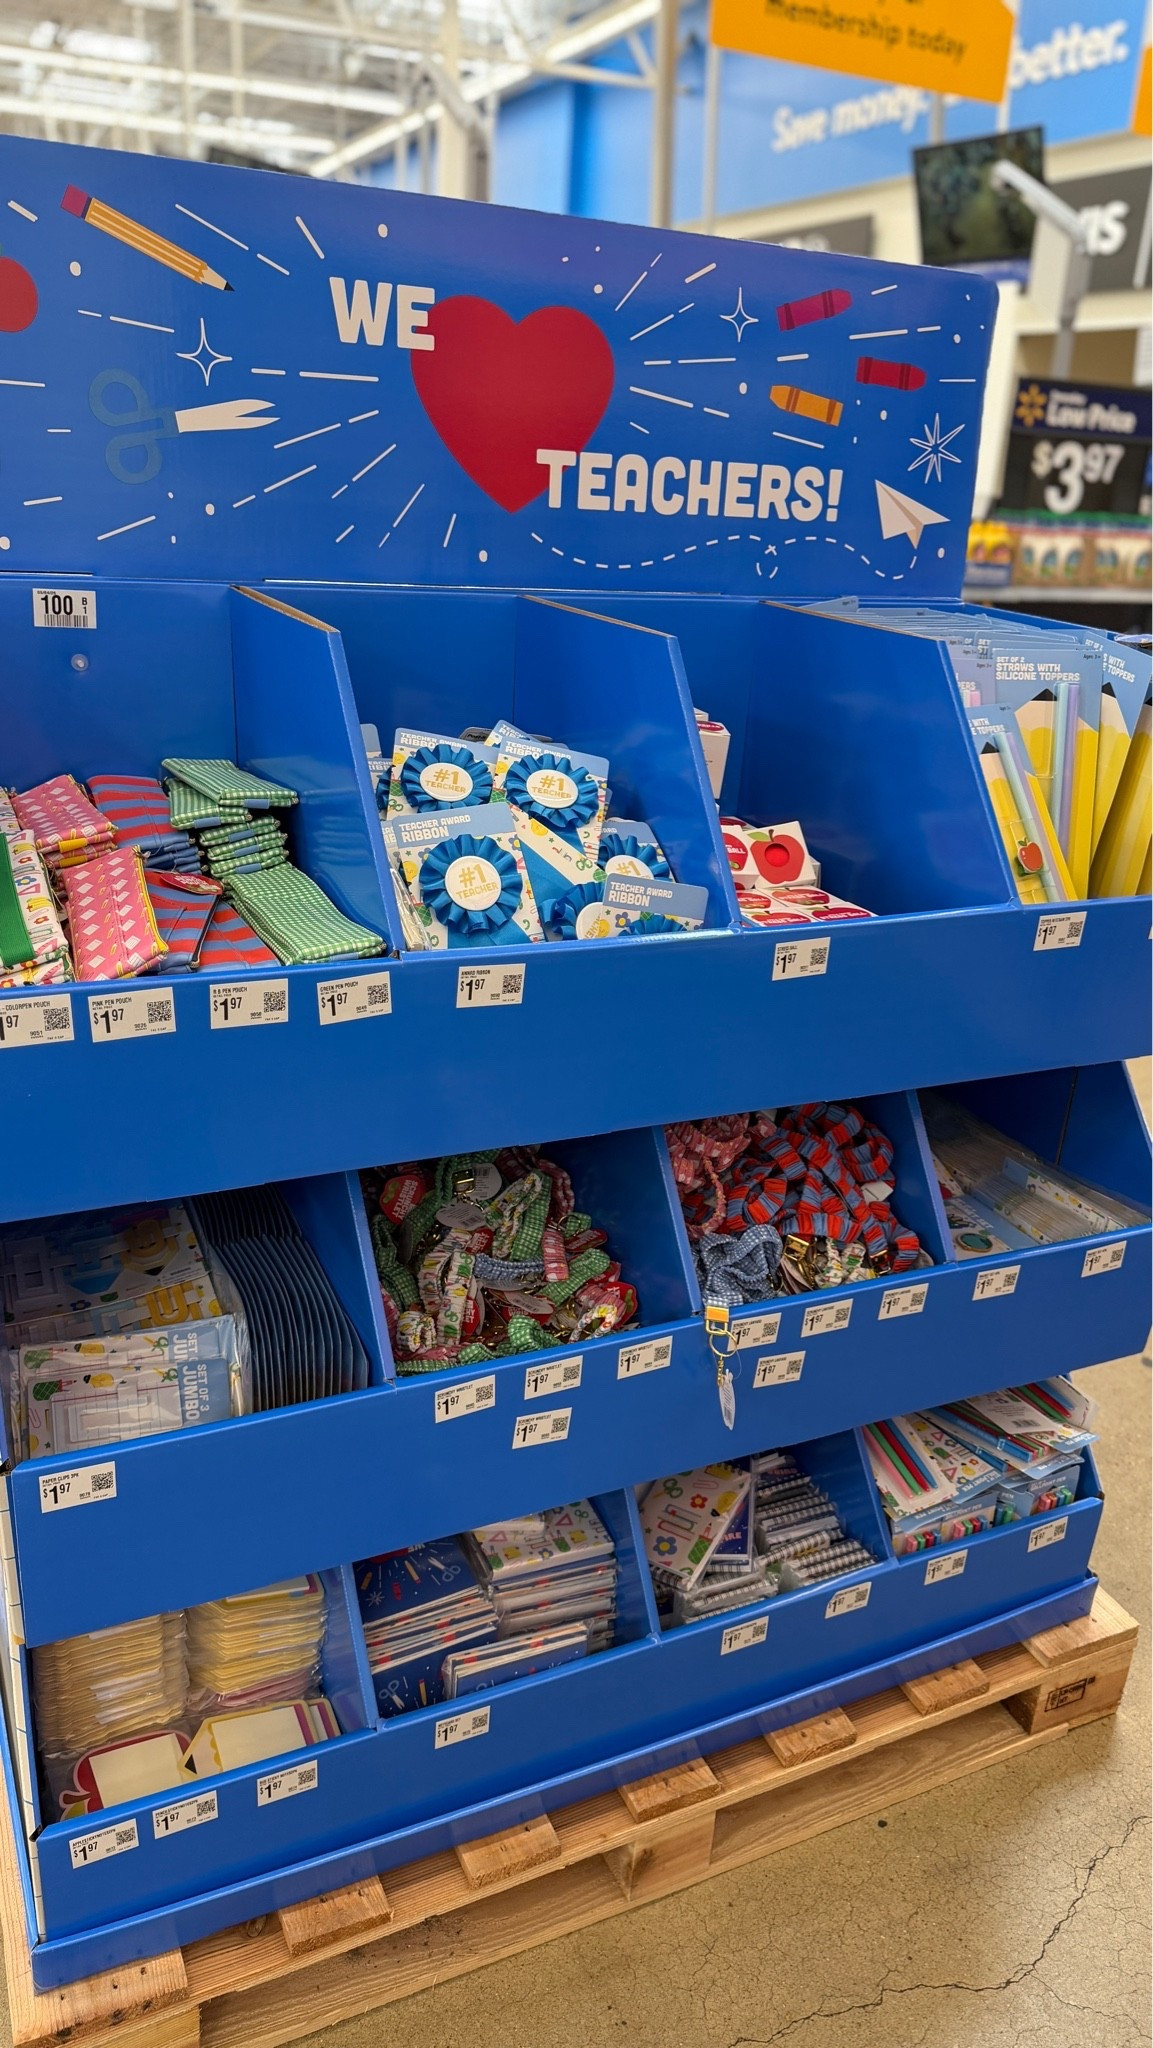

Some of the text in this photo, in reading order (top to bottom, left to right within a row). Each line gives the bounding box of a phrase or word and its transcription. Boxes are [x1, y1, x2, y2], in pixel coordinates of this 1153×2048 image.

[907, 26, 967, 65] today
[329, 277, 436, 351] WE
[1046, 403, 1138, 434] Low Price
[536, 449, 844, 522] TEACHERS!
[41, 595, 88, 615] 100 B
[83, 606, 87, 614] 1
[996, 663, 1061, 672] STRAWS WITH
[1108, 655, 1126, 669] WITH
[996, 672, 1080, 681] SILICONE TOPPERS
[1107, 664, 1136, 683] TOPPERS
[974, 718, 989, 727] WITH
[978, 724, 1006, 735] TOPPERS
[400, 732, 438, 745] TEACHER
[506, 741, 542, 754] TEACHER
[433, 768, 460, 785] #1
[540, 774, 566, 791] #1
[425, 780, 467, 795] TEACHER
[531, 785, 572, 799] TEACHER
[399, 815, 471, 832] TEACHER AWARD
[402, 826, 450, 844] RIBBON
[458, 863, 487, 887] #1
[616, 860, 641, 876] #1
[456, 881, 499, 900] TEACHER
[608, 890, 651, 907] RIBBON
[610, 882, 673, 899] TEACHER AWARD
[319, 984, 335, 992] GREEN
[345, 981, 359, 989] POUCH
[33, 1000, 51, 1009] POUCH
[116, 997, 132, 1005] POUCH
[187, 1332, 198, 1353] SET
[182, 1365, 200, 1420] JUMBO
[197, 1364, 210, 1412] SET OF 3
[42, 1477, 59, 1485] PAPER
[59, 1474, 70, 1482] CLIPS
